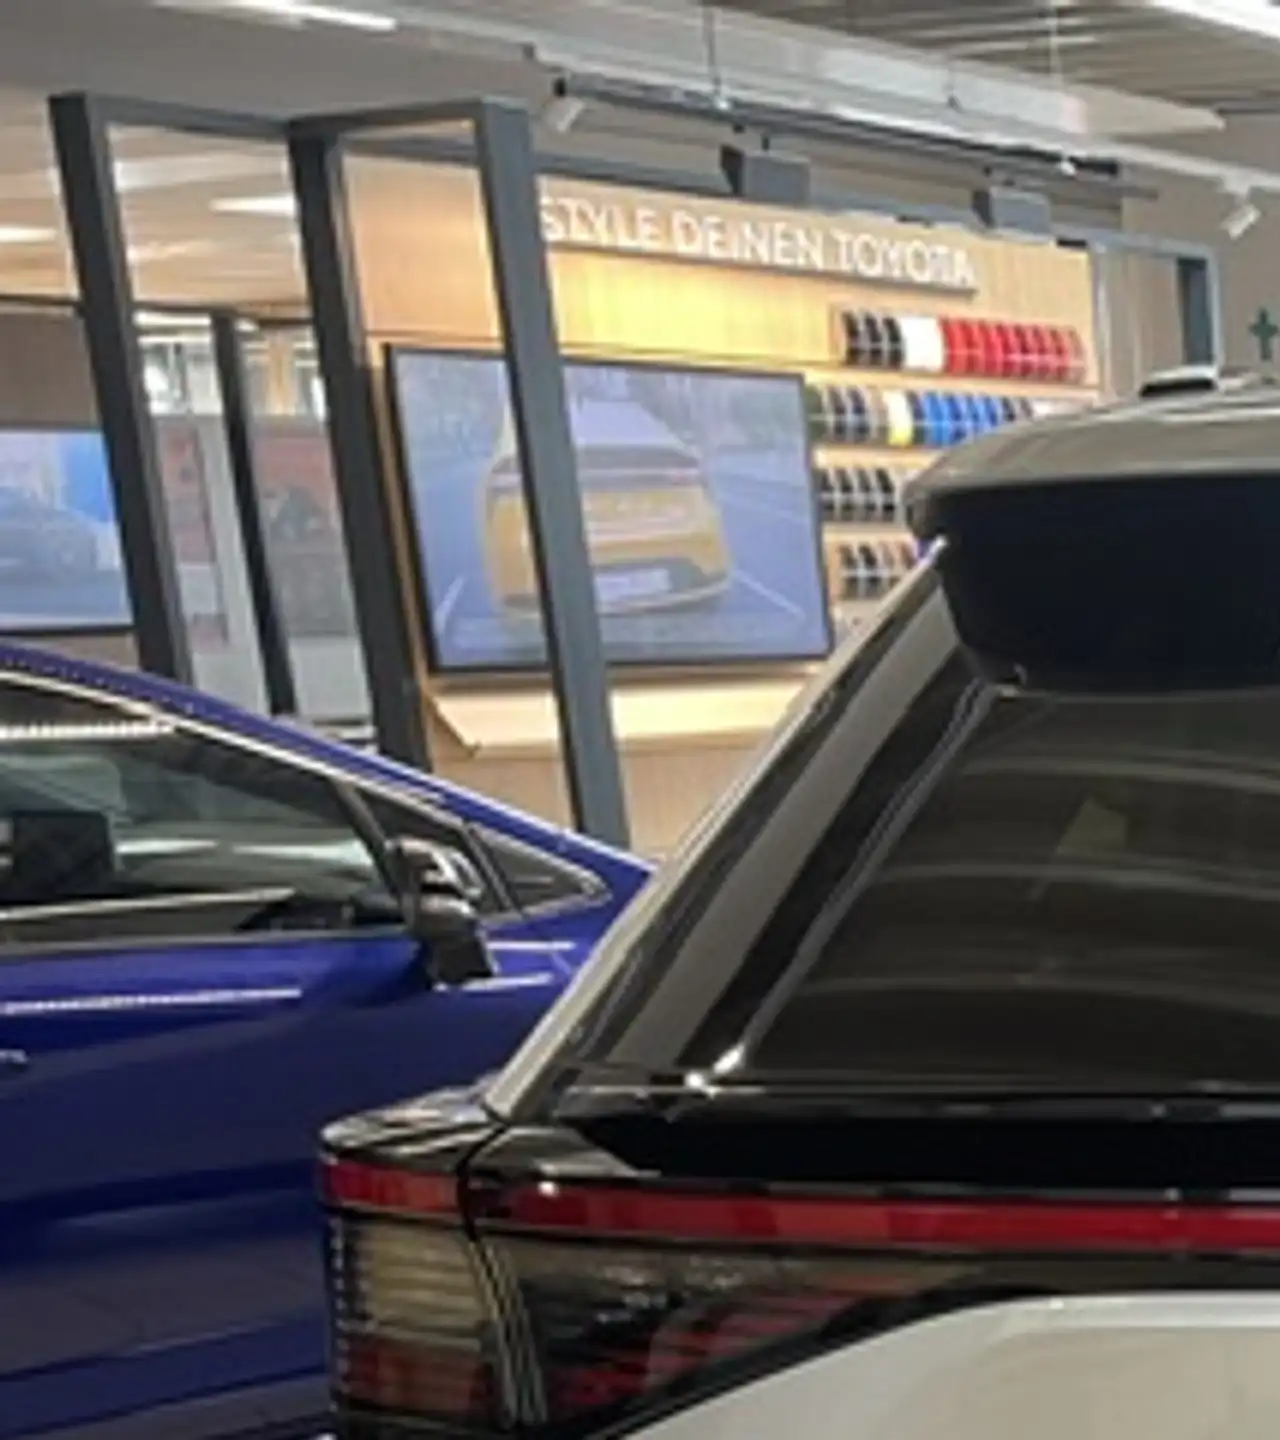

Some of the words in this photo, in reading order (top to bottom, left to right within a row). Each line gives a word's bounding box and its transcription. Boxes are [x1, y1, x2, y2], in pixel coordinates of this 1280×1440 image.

[541, 197, 660, 249] STYLE
[671, 209, 824, 271] DEINEN
[830, 228, 975, 290] TOYOTA
